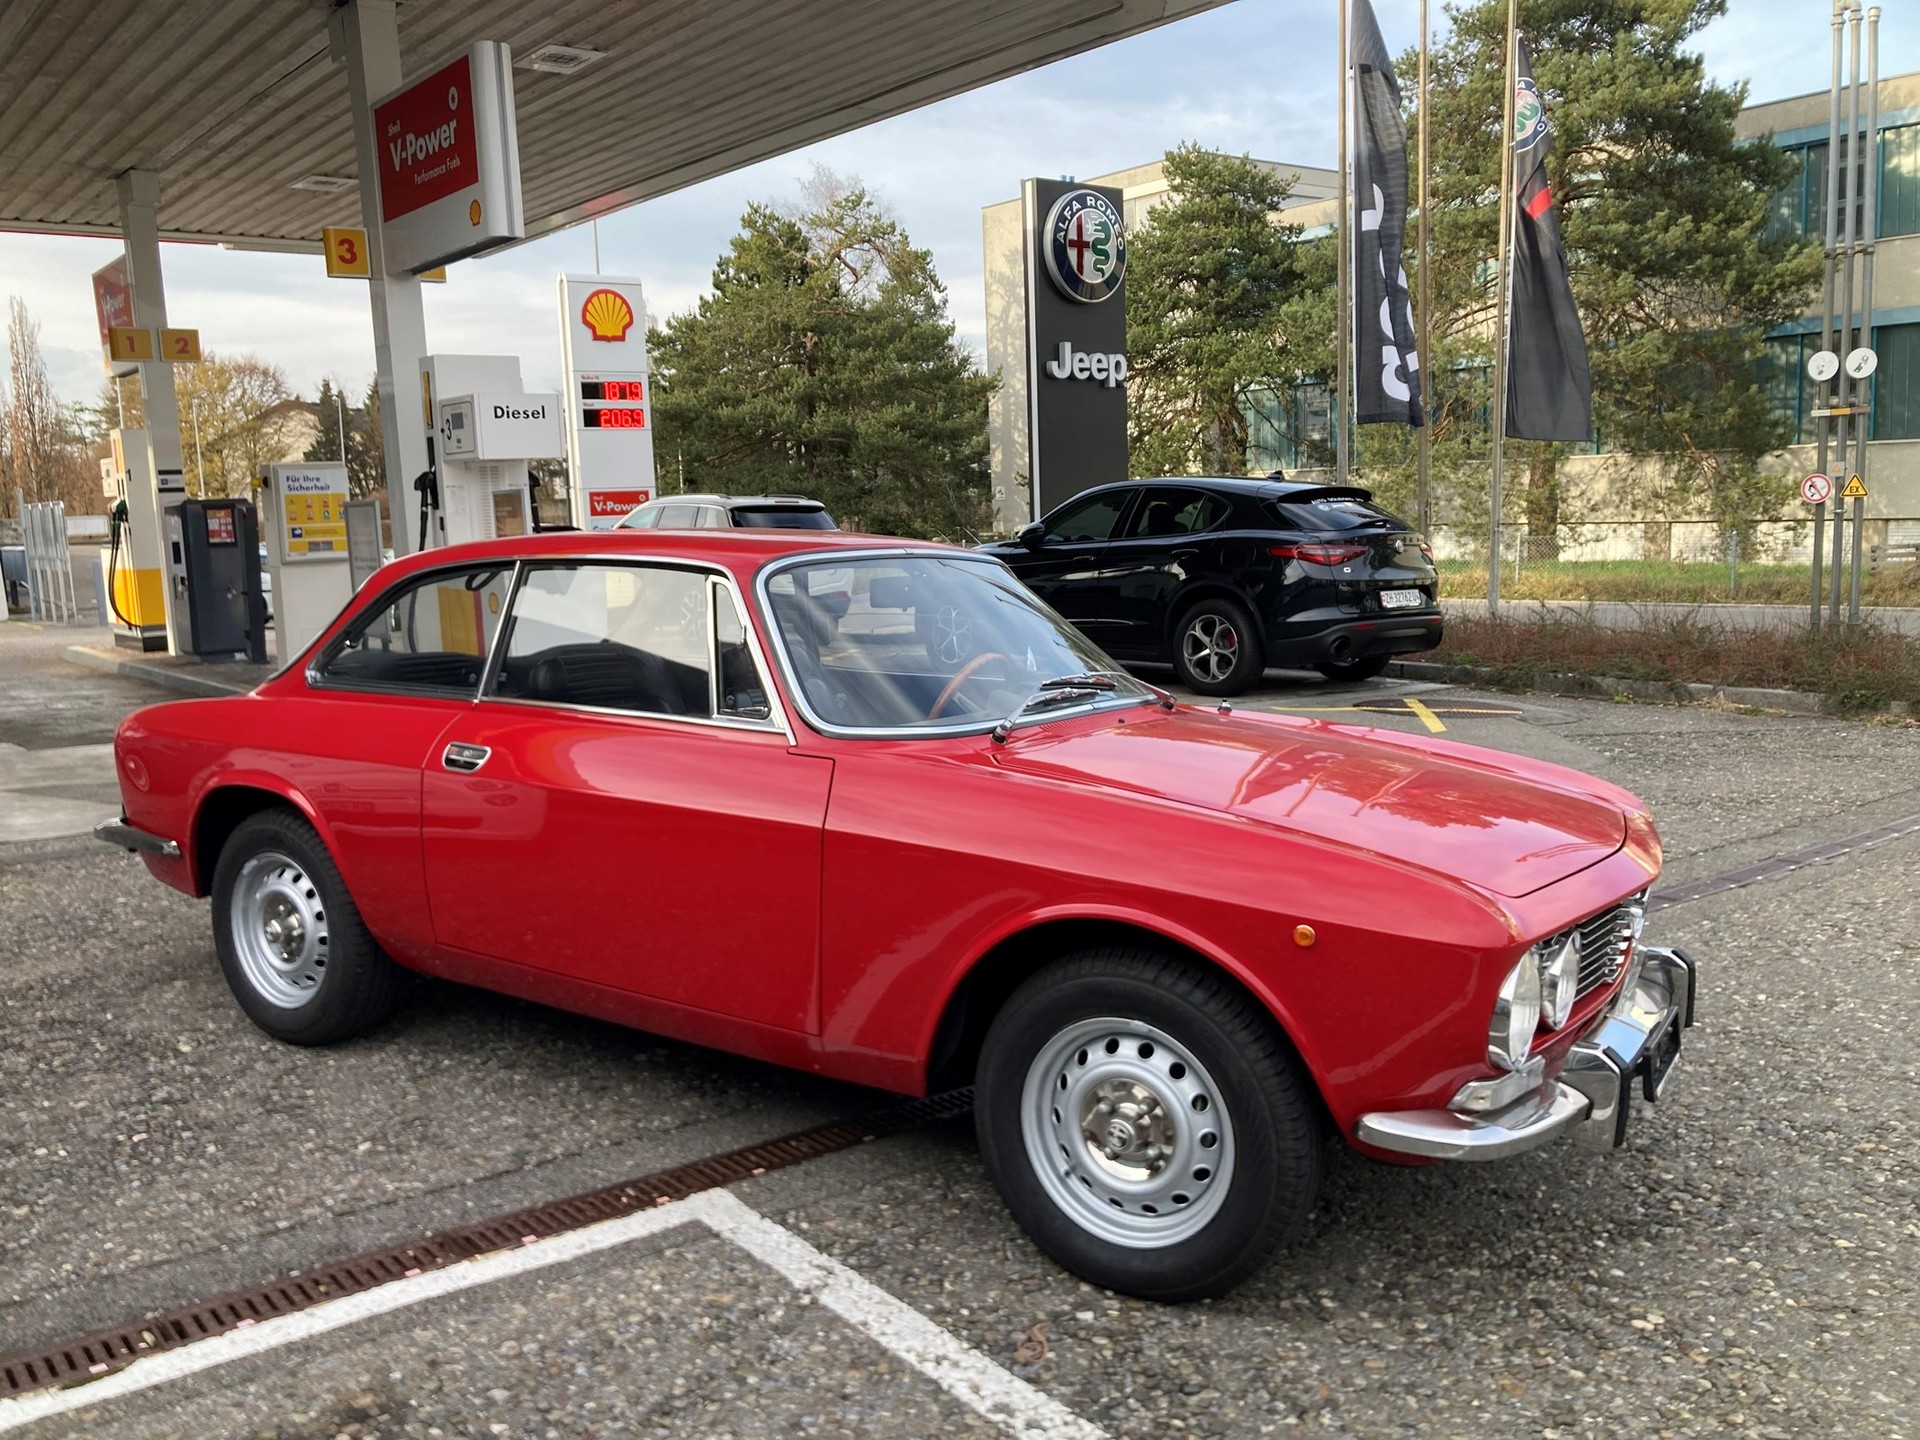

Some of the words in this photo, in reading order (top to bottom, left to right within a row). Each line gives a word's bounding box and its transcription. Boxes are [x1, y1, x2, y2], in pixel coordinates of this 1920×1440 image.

[389, 118, 457, 172] V-Power
[414, 163, 446, 187] Performance
[446, 153, 461, 171] Fuels
[1056, 200, 1082, 244] ALFA
[1086, 195, 1124, 251] ROMEO
[337, 238, 358, 265] 3
[126, 335, 136, 353] 1
[174, 336, 190, 355] 2
[1046, 341, 1128, 388] Jeep
[603, 381, 643, 401] 187.9
[493, 405, 546, 420] Diesel
[600, 408, 645, 428] 206.9
[445, 418, 453, 441] 3
[286, 475, 301, 483] Für
[302, 475, 321, 483] Ihre
[287, 483, 330, 492] Sicherheit
[1849, 485, 1860, 494] EX
[593, 500, 641, 512] V-Powe
